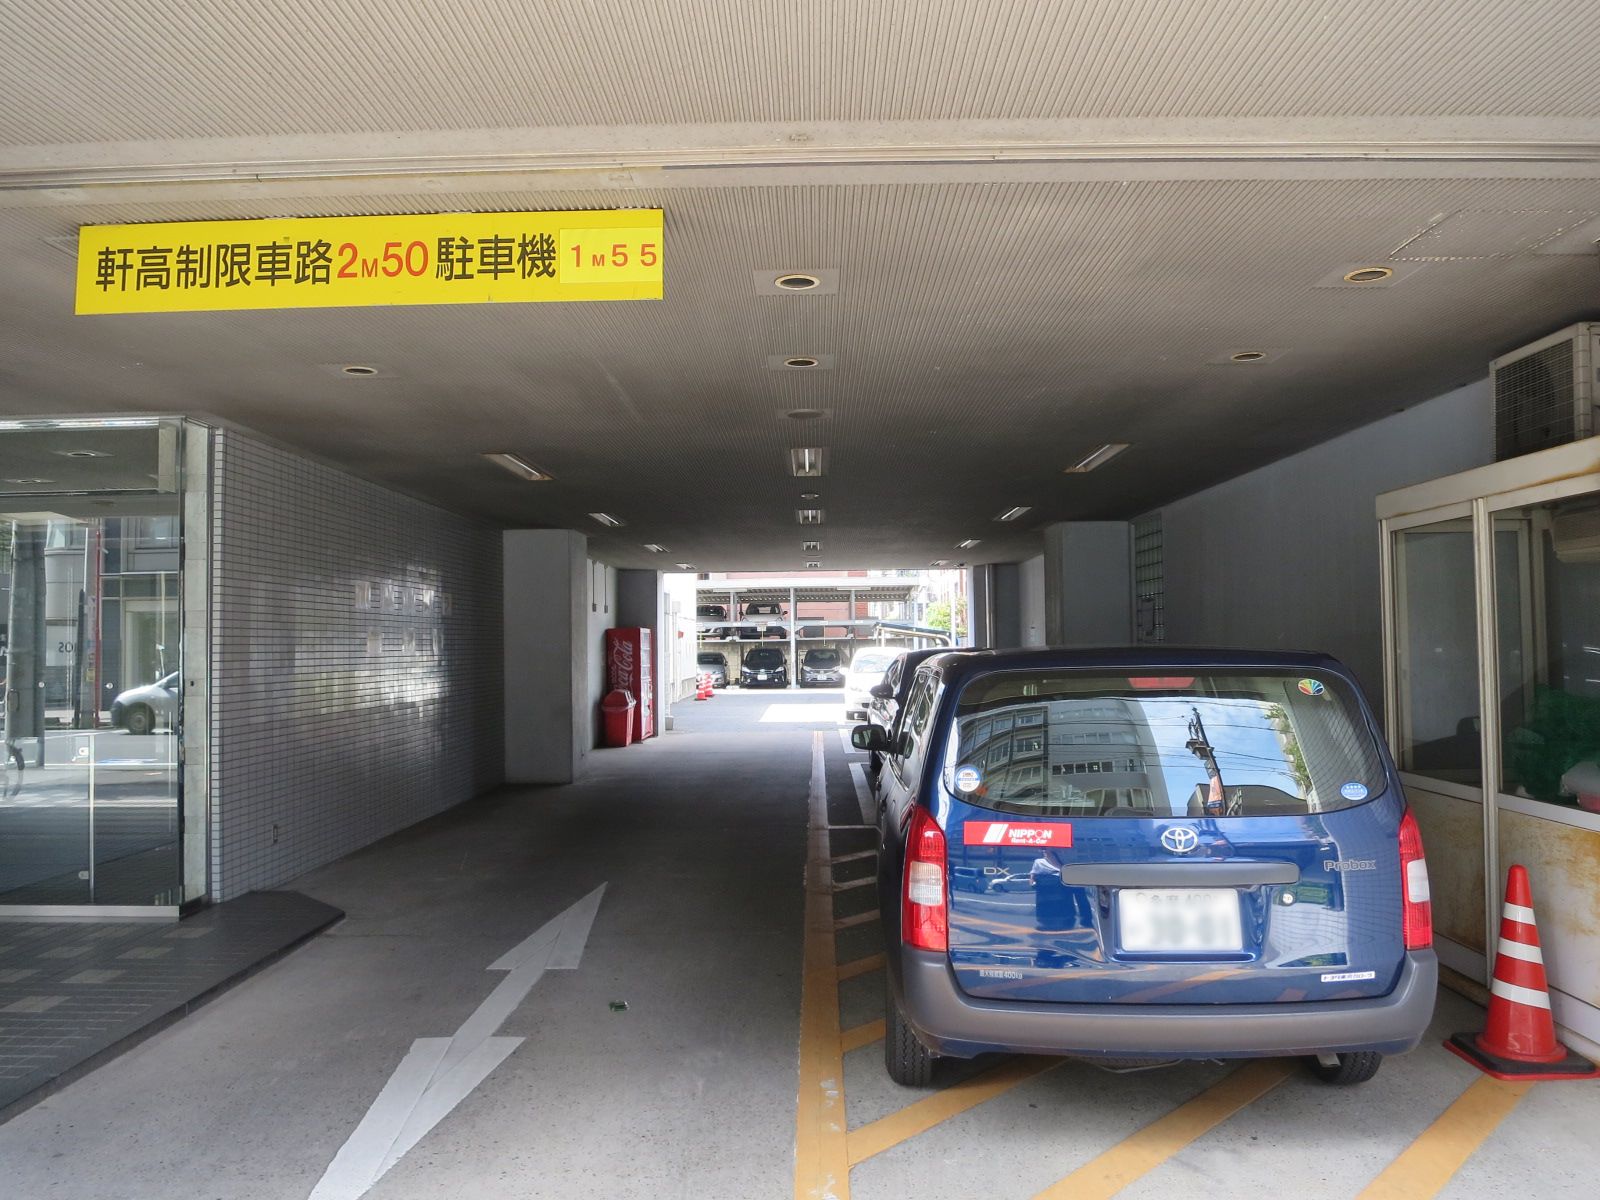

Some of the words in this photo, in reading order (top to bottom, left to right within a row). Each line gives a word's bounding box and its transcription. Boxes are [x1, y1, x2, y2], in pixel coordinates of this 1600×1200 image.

[95, 239, 334, 292] 軒高制限車路
[435, 233, 556, 281] 駐車機
[1008, 828, 1052, 839] NIPPON
[983, 866, 1010, 876] DX
[1323, 859, 1377, 872] Probox
